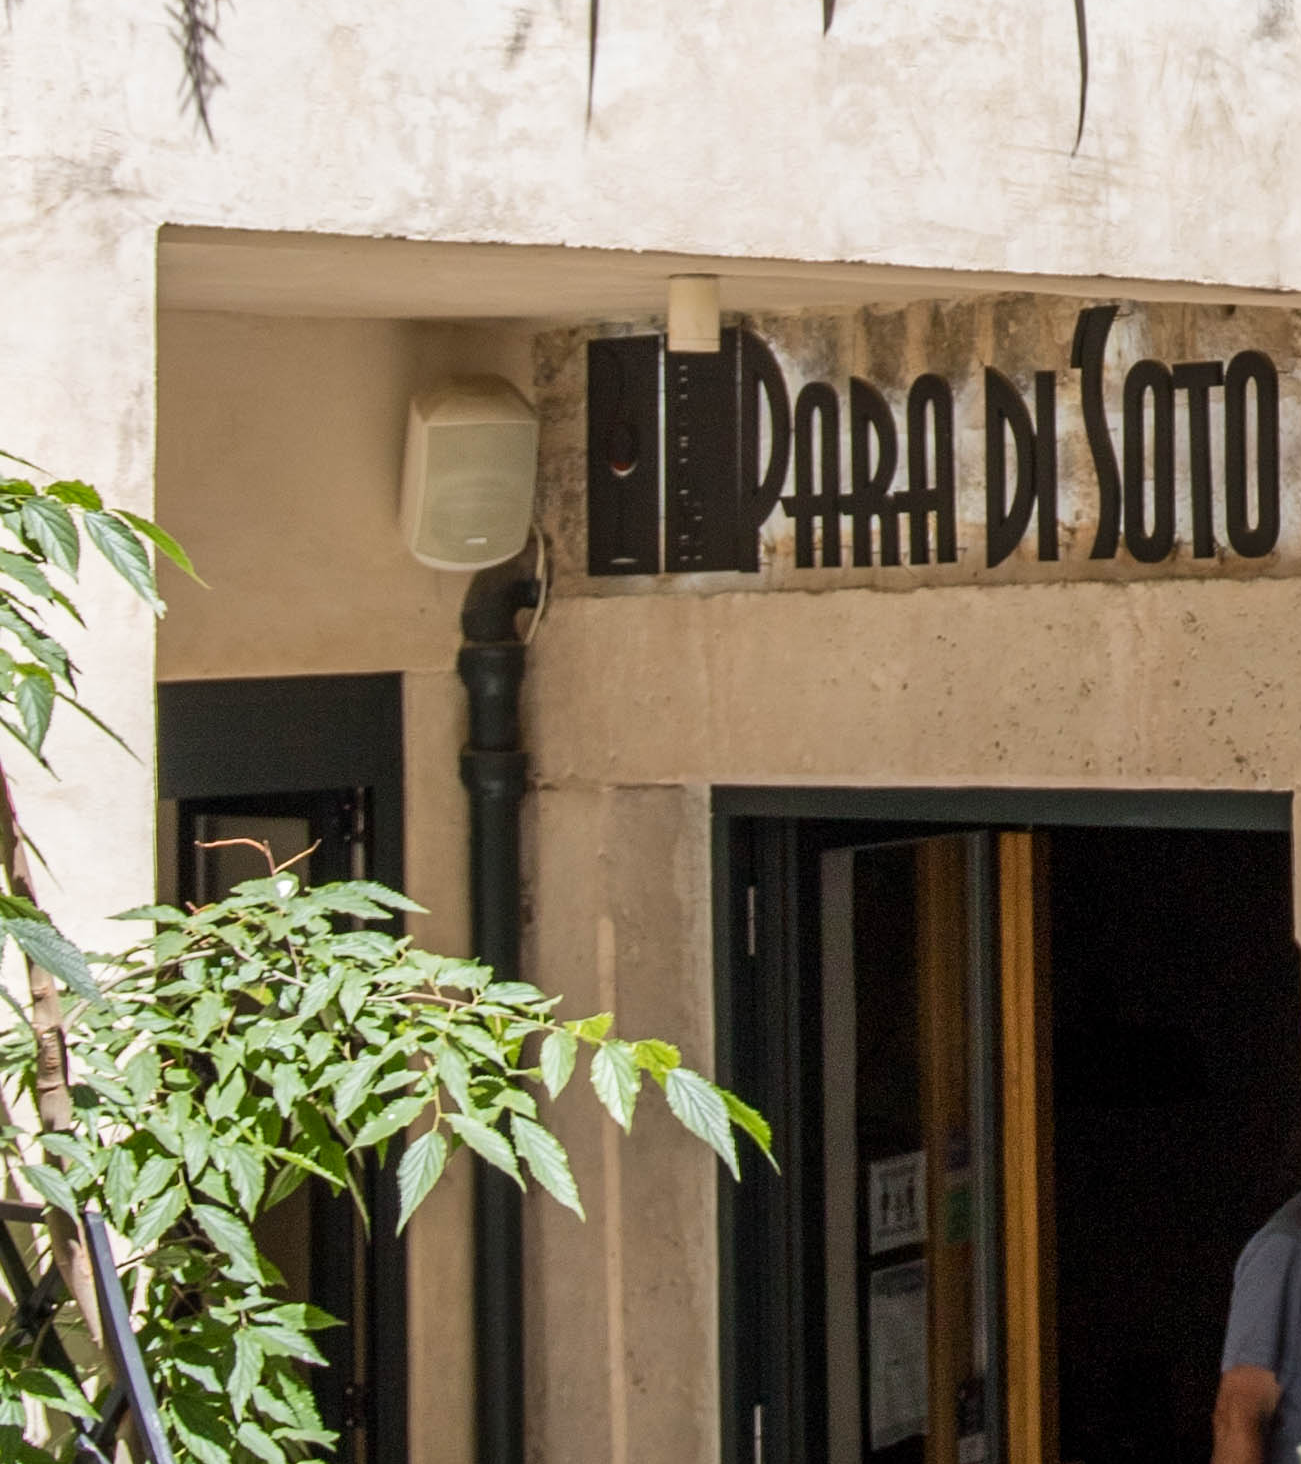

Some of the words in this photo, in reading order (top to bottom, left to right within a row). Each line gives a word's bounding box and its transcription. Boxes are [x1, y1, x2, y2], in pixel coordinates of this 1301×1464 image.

[739, 326, 958, 573] PARA
[984, 364, 1060, 570] DI
[1069, 304, 1282, 567] SOTO
